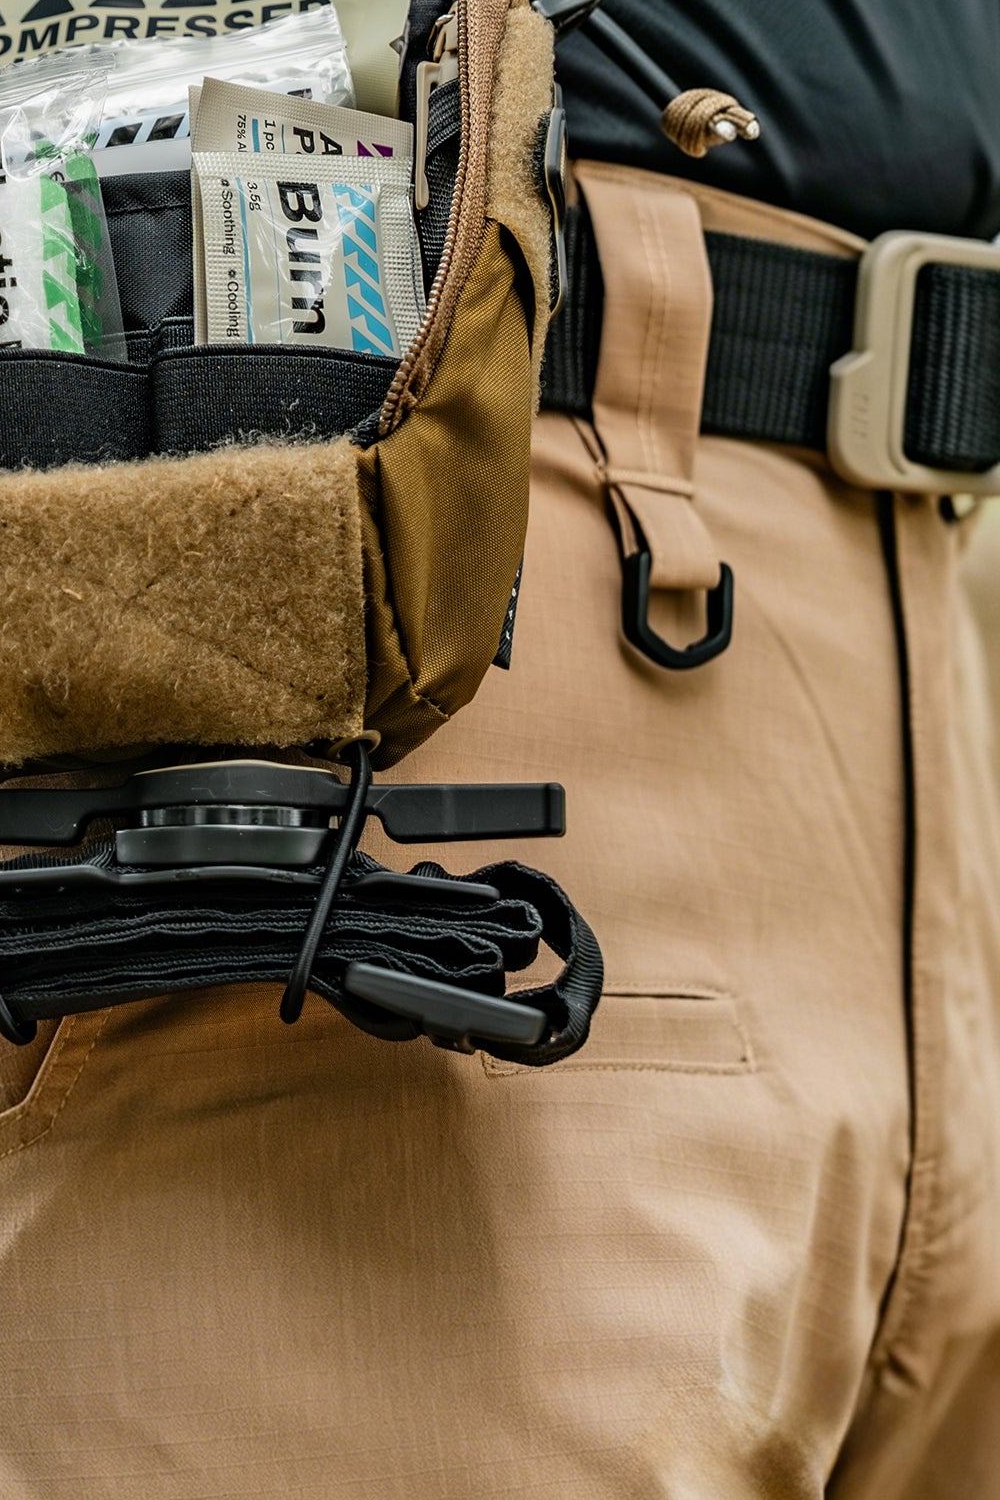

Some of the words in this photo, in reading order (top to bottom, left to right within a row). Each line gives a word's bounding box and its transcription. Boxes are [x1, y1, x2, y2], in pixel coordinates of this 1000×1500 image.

[236, 115, 247, 140] 75%
[264, 120, 276, 128] 1
[263, 132, 275, 151] pc
[247, 181, 262, 212] 3.5g
[221, 191, 236, 256] Soothing
[276, 180, 327, 335] Burn
[227, 281, 240, 338] Cooling
